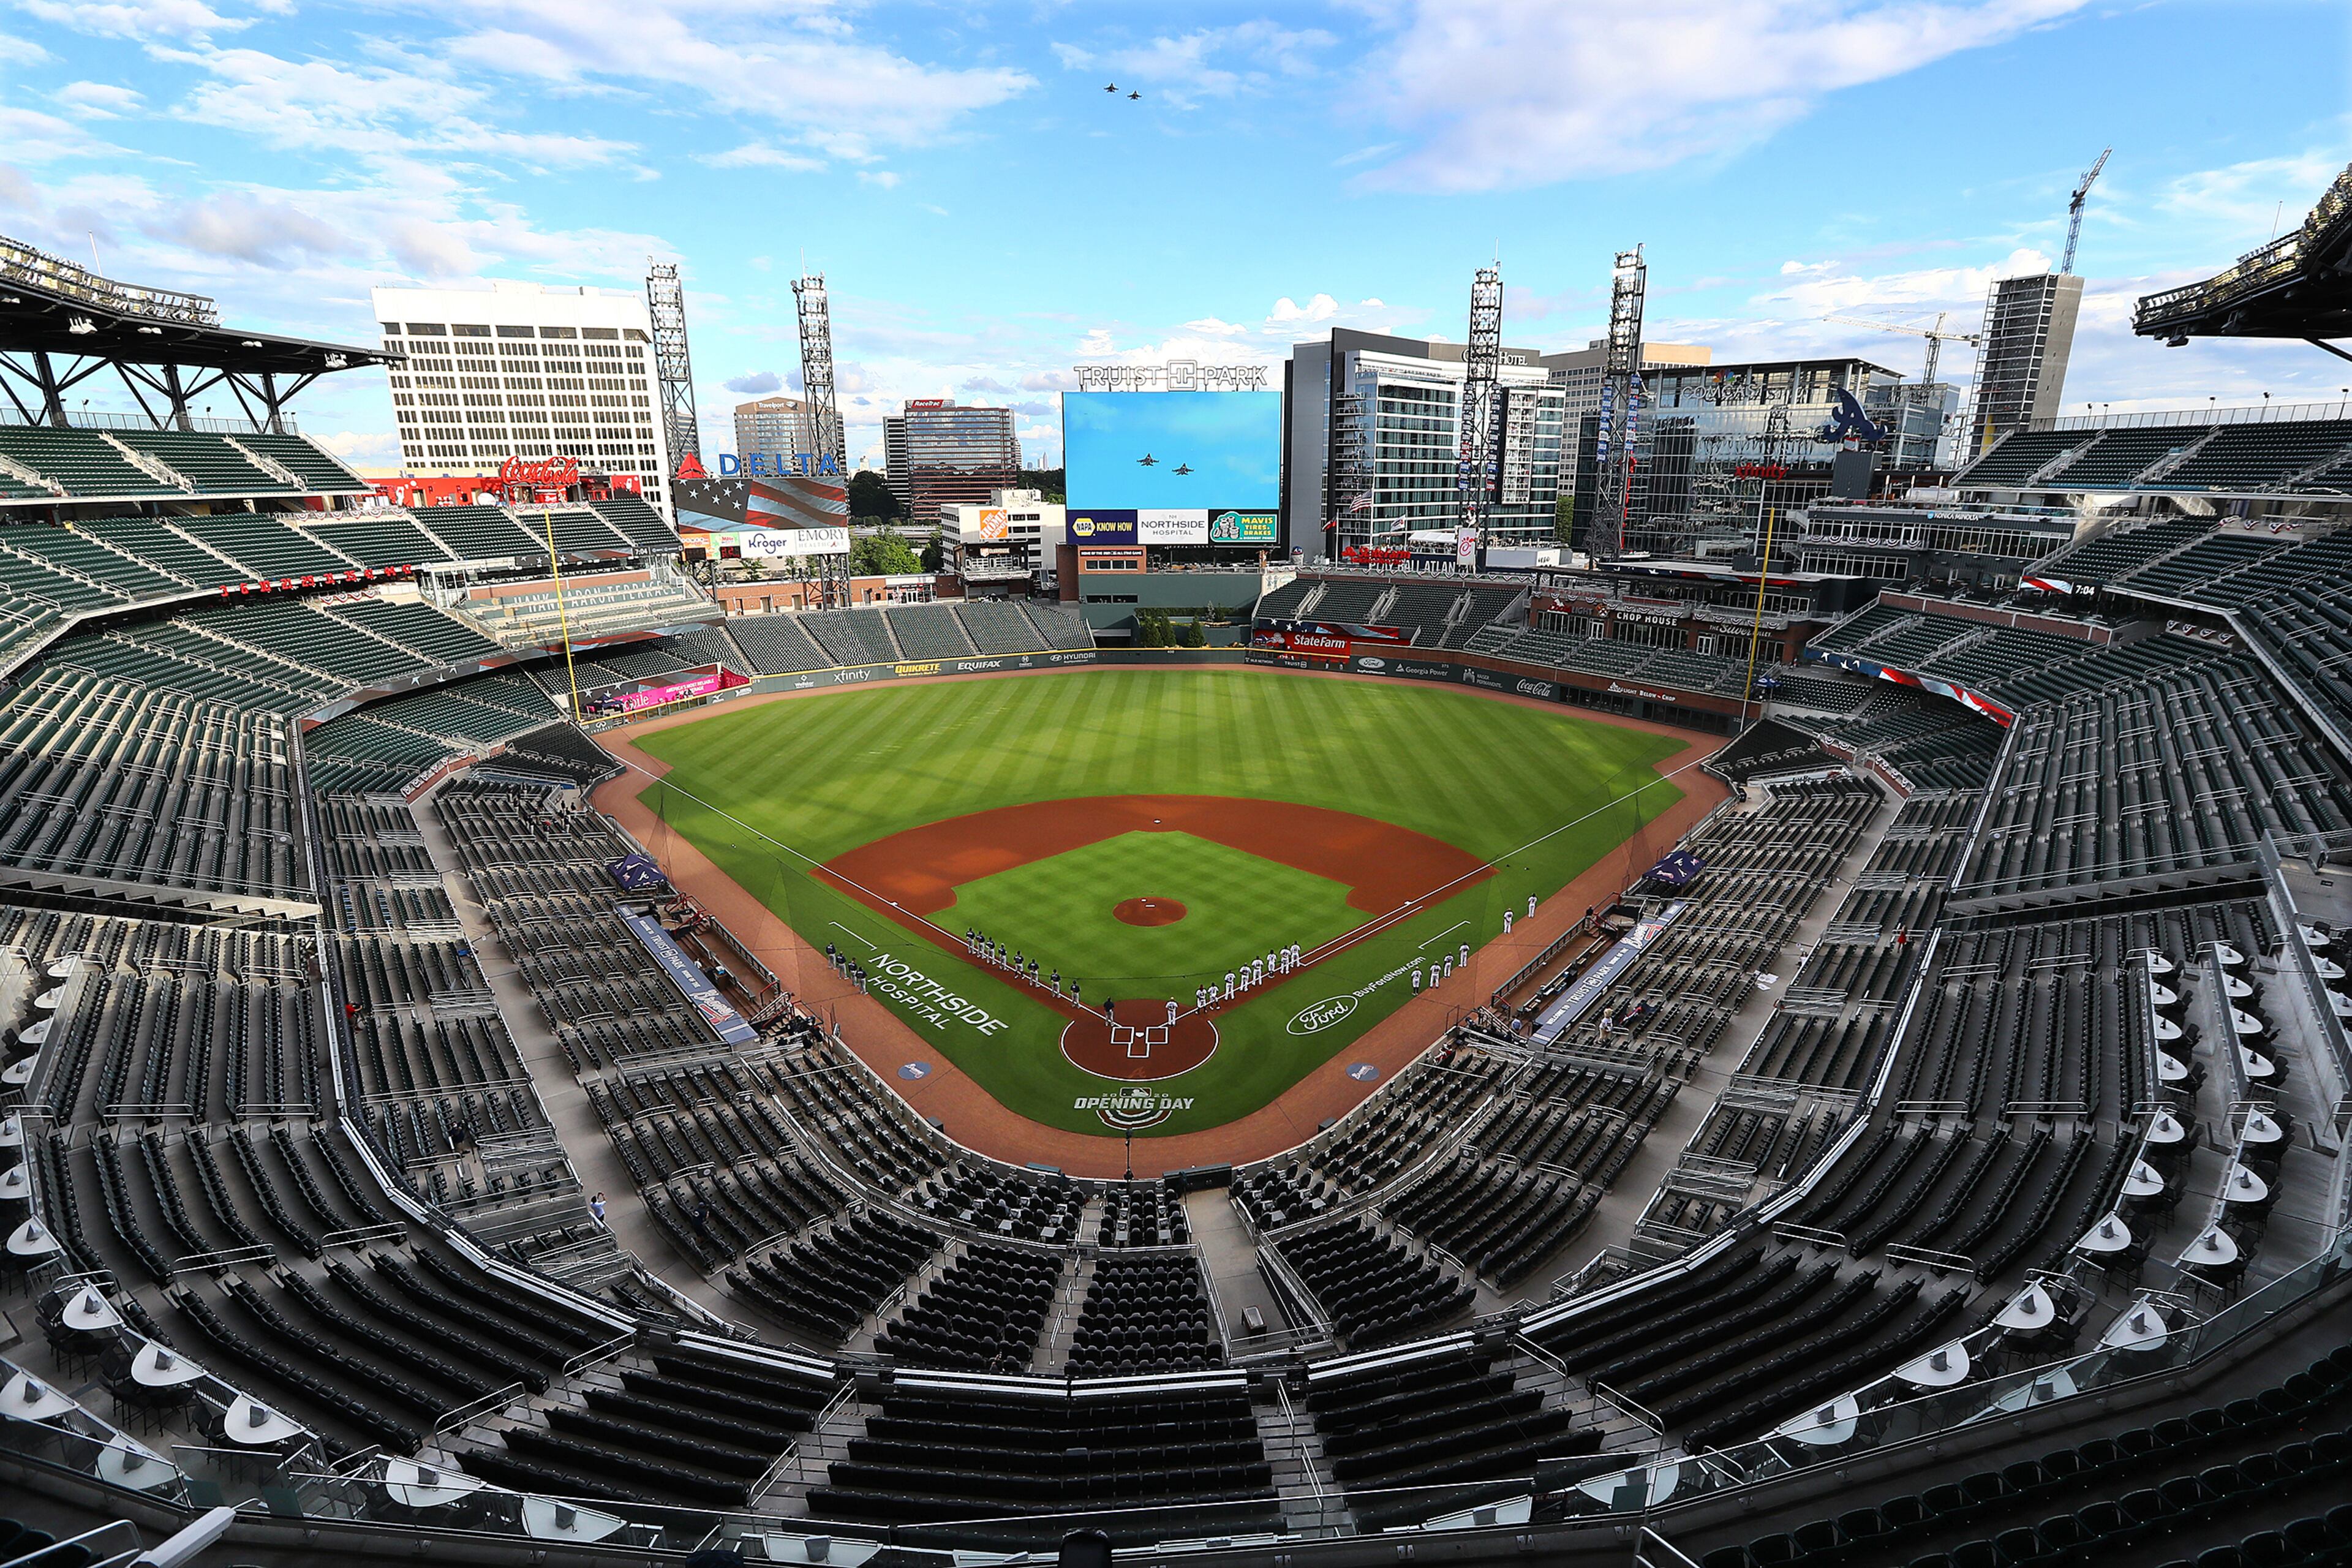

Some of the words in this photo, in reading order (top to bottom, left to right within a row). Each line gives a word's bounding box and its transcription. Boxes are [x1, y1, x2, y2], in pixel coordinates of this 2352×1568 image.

[1499, 351, 1528, 366] HOTEL
[1074, 366, 1161, 385] TRUIST
[1203, 366, 1268, 385] PARK
[758, 401, 785, 410] Travelport
[719, 453, 839, 476] DELTA
[1735, 462, 1789, 481] xfinity
[980, 510, 1007, 539] HOME
[1076, 522, 1092, 532] NAPA
[1096, 522, 1115, 532] KNOW
[1117, 522, 1133, 532] HOW
[798, 529, 845, 541] EMORY
[748, 533, 787, 554] Kroger
[219, 585, 229, 597] 3
[280, 578, 294, 589] 21
[2076, 585, 2095, 595] 7:04
[514, 593, 564, 612] HANK
[565, 587, 614, 608] AARON
[607, 581, 677, 601] TERRACE
[1617, 612, 1641, 623] CHOP
[1645, 616, 1678, 627] HOUSE
[1719, 624, 1751, 636] Silver
[895, 663, 941, 673] QUIKRETE
[957, 660, 1002, 671] EQUIFAX
[1363, 658, 1380, 667] Ford
[834, 668, 871, 684] xfinity
[1406, 666, 1428, 675] Georgia
[1430, 668, 1447, 677] Power
[650, 935, 670, 954] TRUIST
[668, 954, 686, 970] PARK
[1353, 956, 1426, 998] BuyFordNow.com
[1567, 984, 1593, 1005] TRUIST
[1594, 965, 1613, 980] PARK
[868, 953, 1009, 1036] NORTHSIDE
[867, 975, 953, 1030] HOSPITAL
[1300, 1001, 1348, 1030] Ford
[1074, 1097, 1155, 1110] OPENING
[1159, 1097, 1195, 1110] DAY
